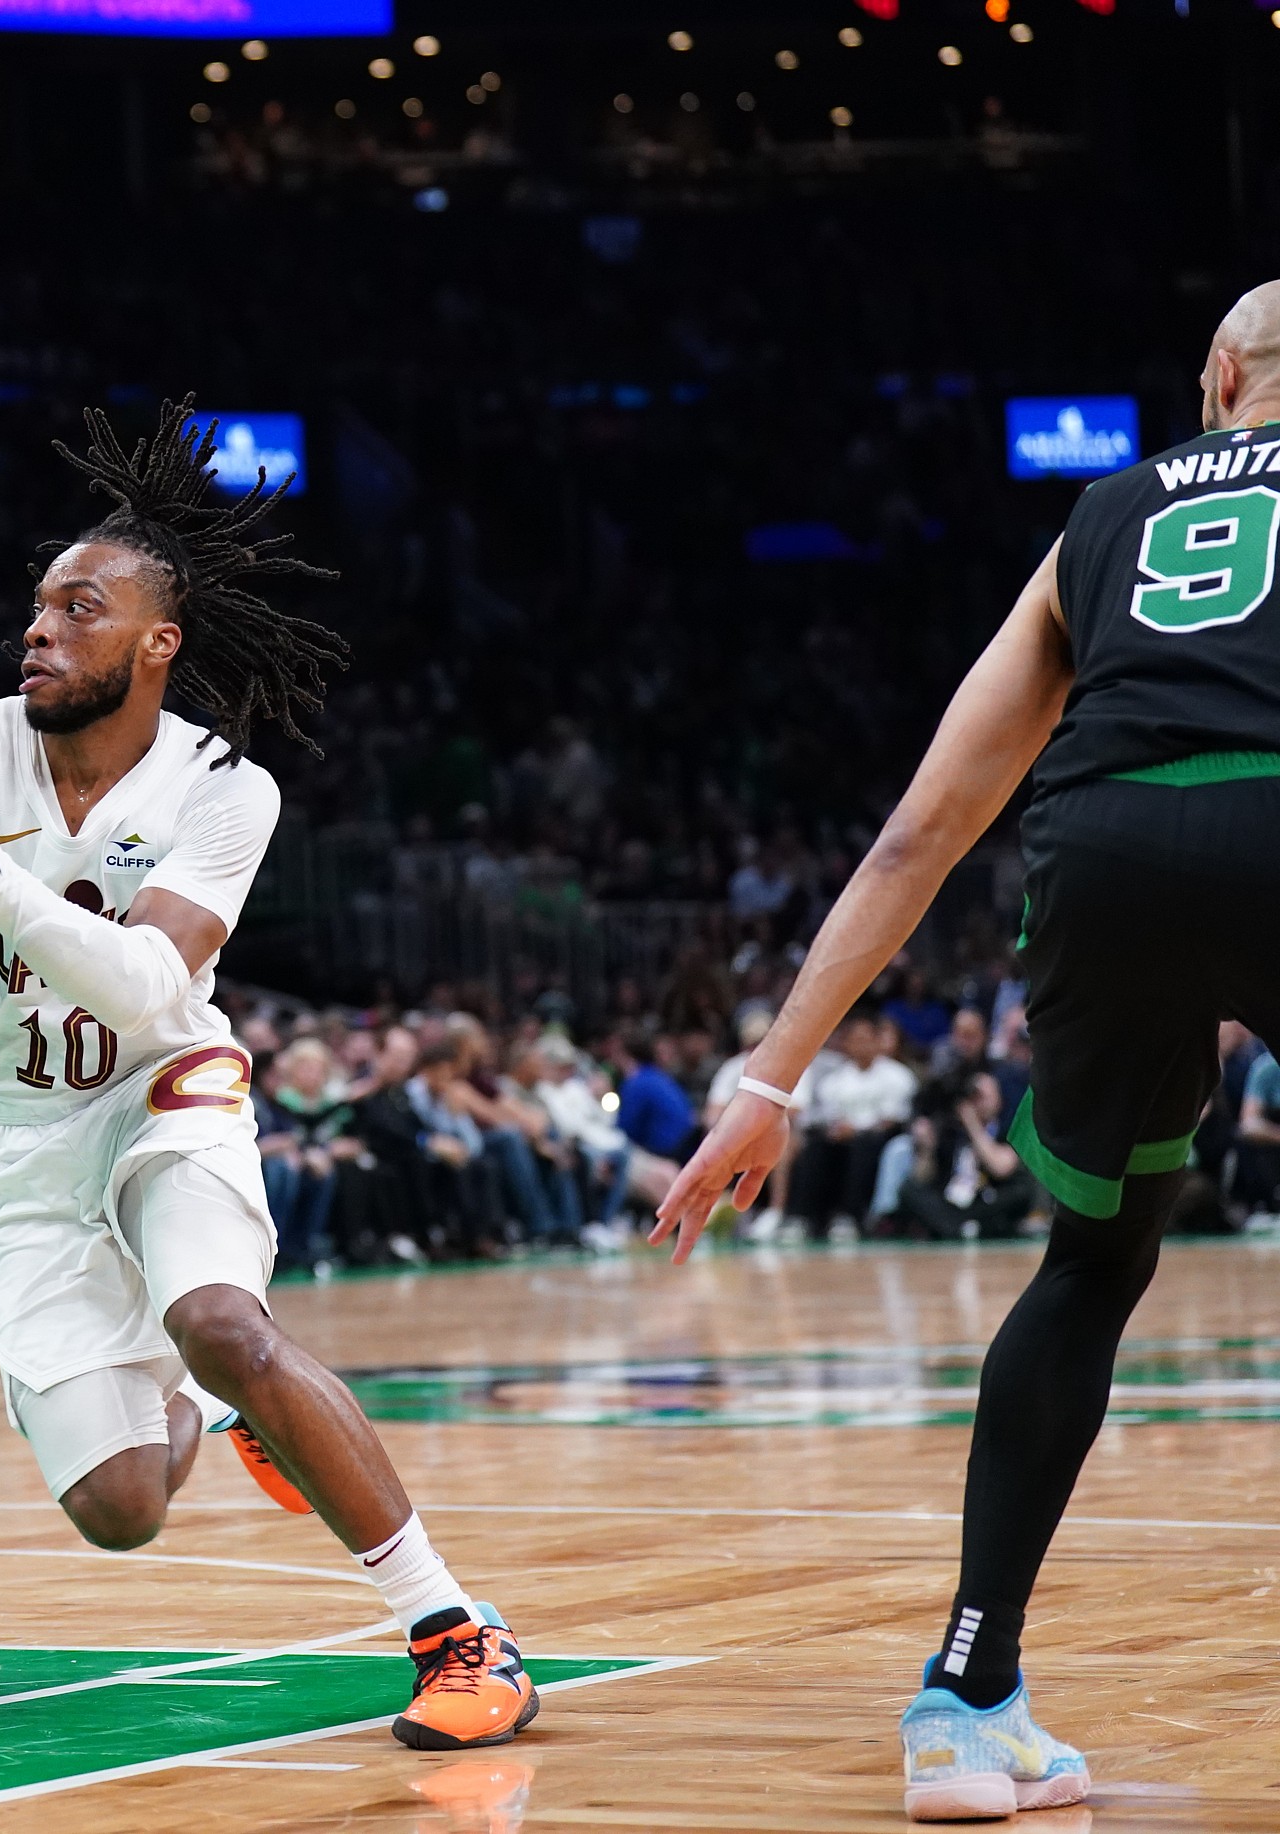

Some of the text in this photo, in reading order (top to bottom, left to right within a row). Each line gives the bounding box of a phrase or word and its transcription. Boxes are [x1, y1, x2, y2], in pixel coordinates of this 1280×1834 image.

[1130, 484, 1280, 634] 9
[106, 855, 156, 868] CLIFFS
[16, 1005, 118, 1091] 10
